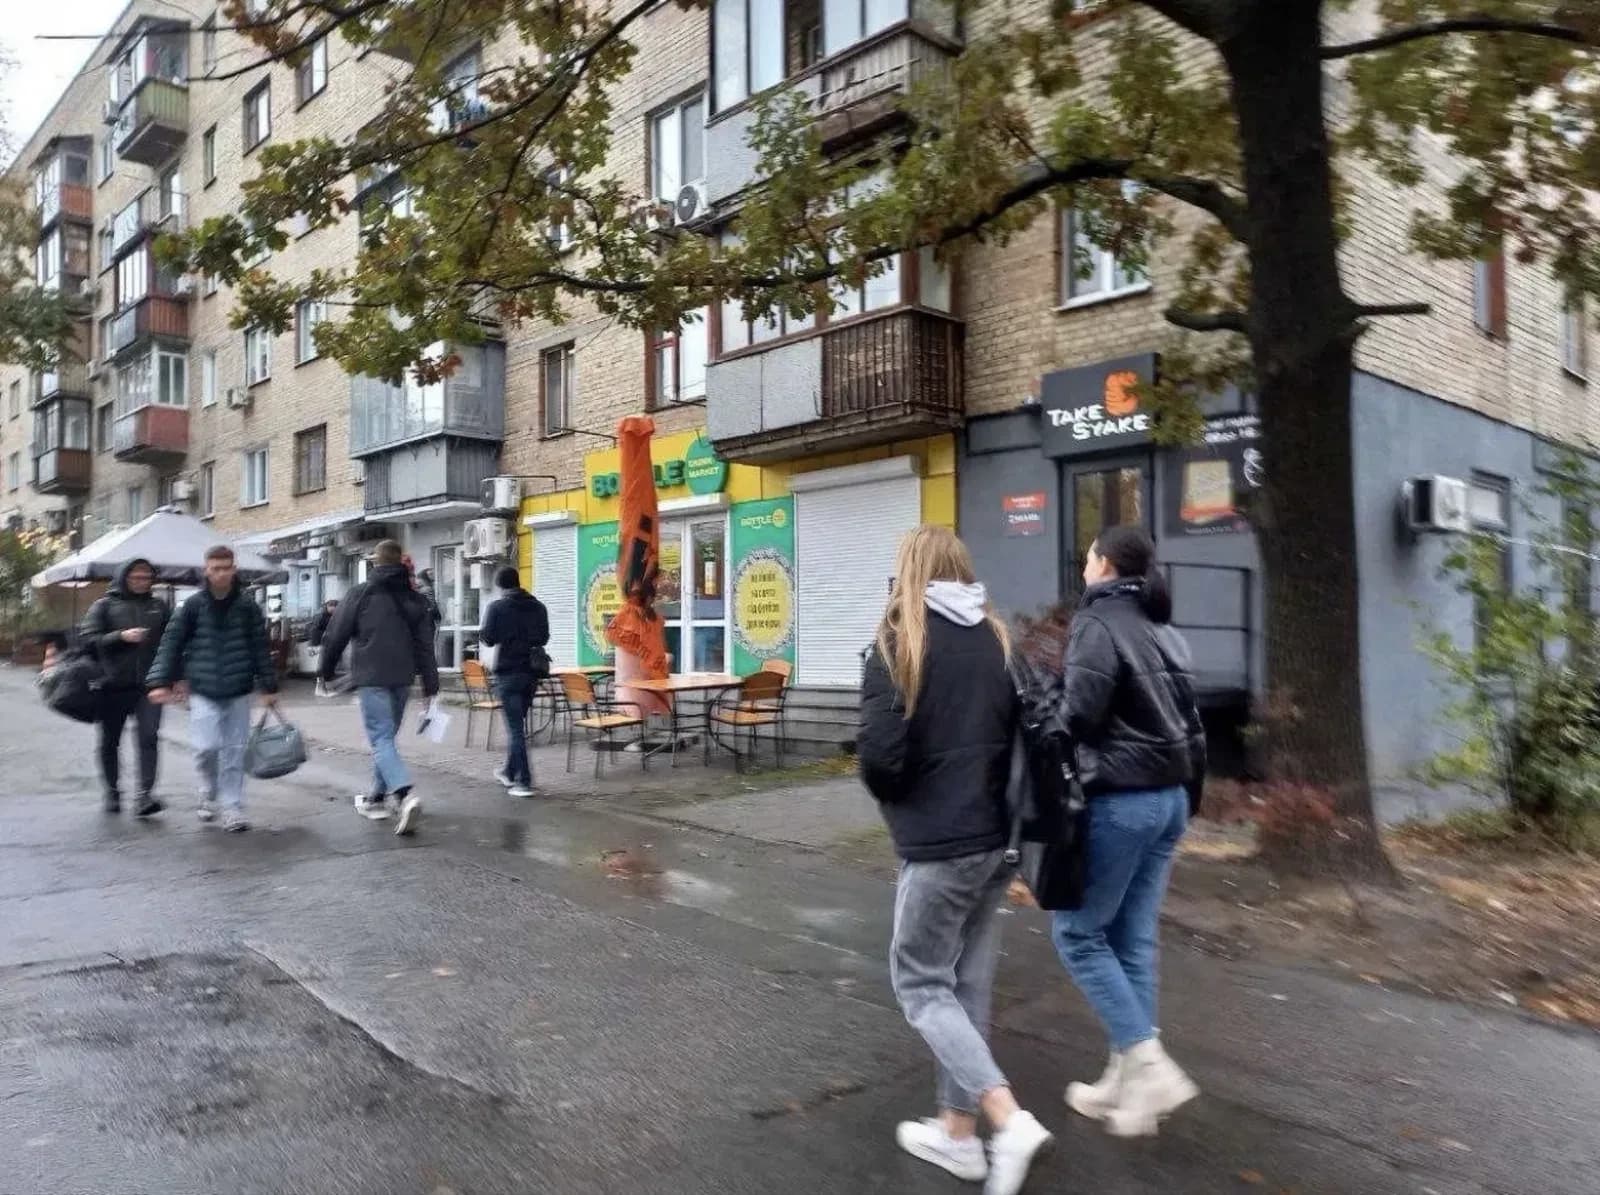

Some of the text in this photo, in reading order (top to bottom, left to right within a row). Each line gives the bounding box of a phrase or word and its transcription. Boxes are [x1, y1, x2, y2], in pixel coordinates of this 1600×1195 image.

[1047, 404, 1104, 427] TAKE
[591, 460, 686, 498] BOLE
[688, 467, 720, 478] MARKET
